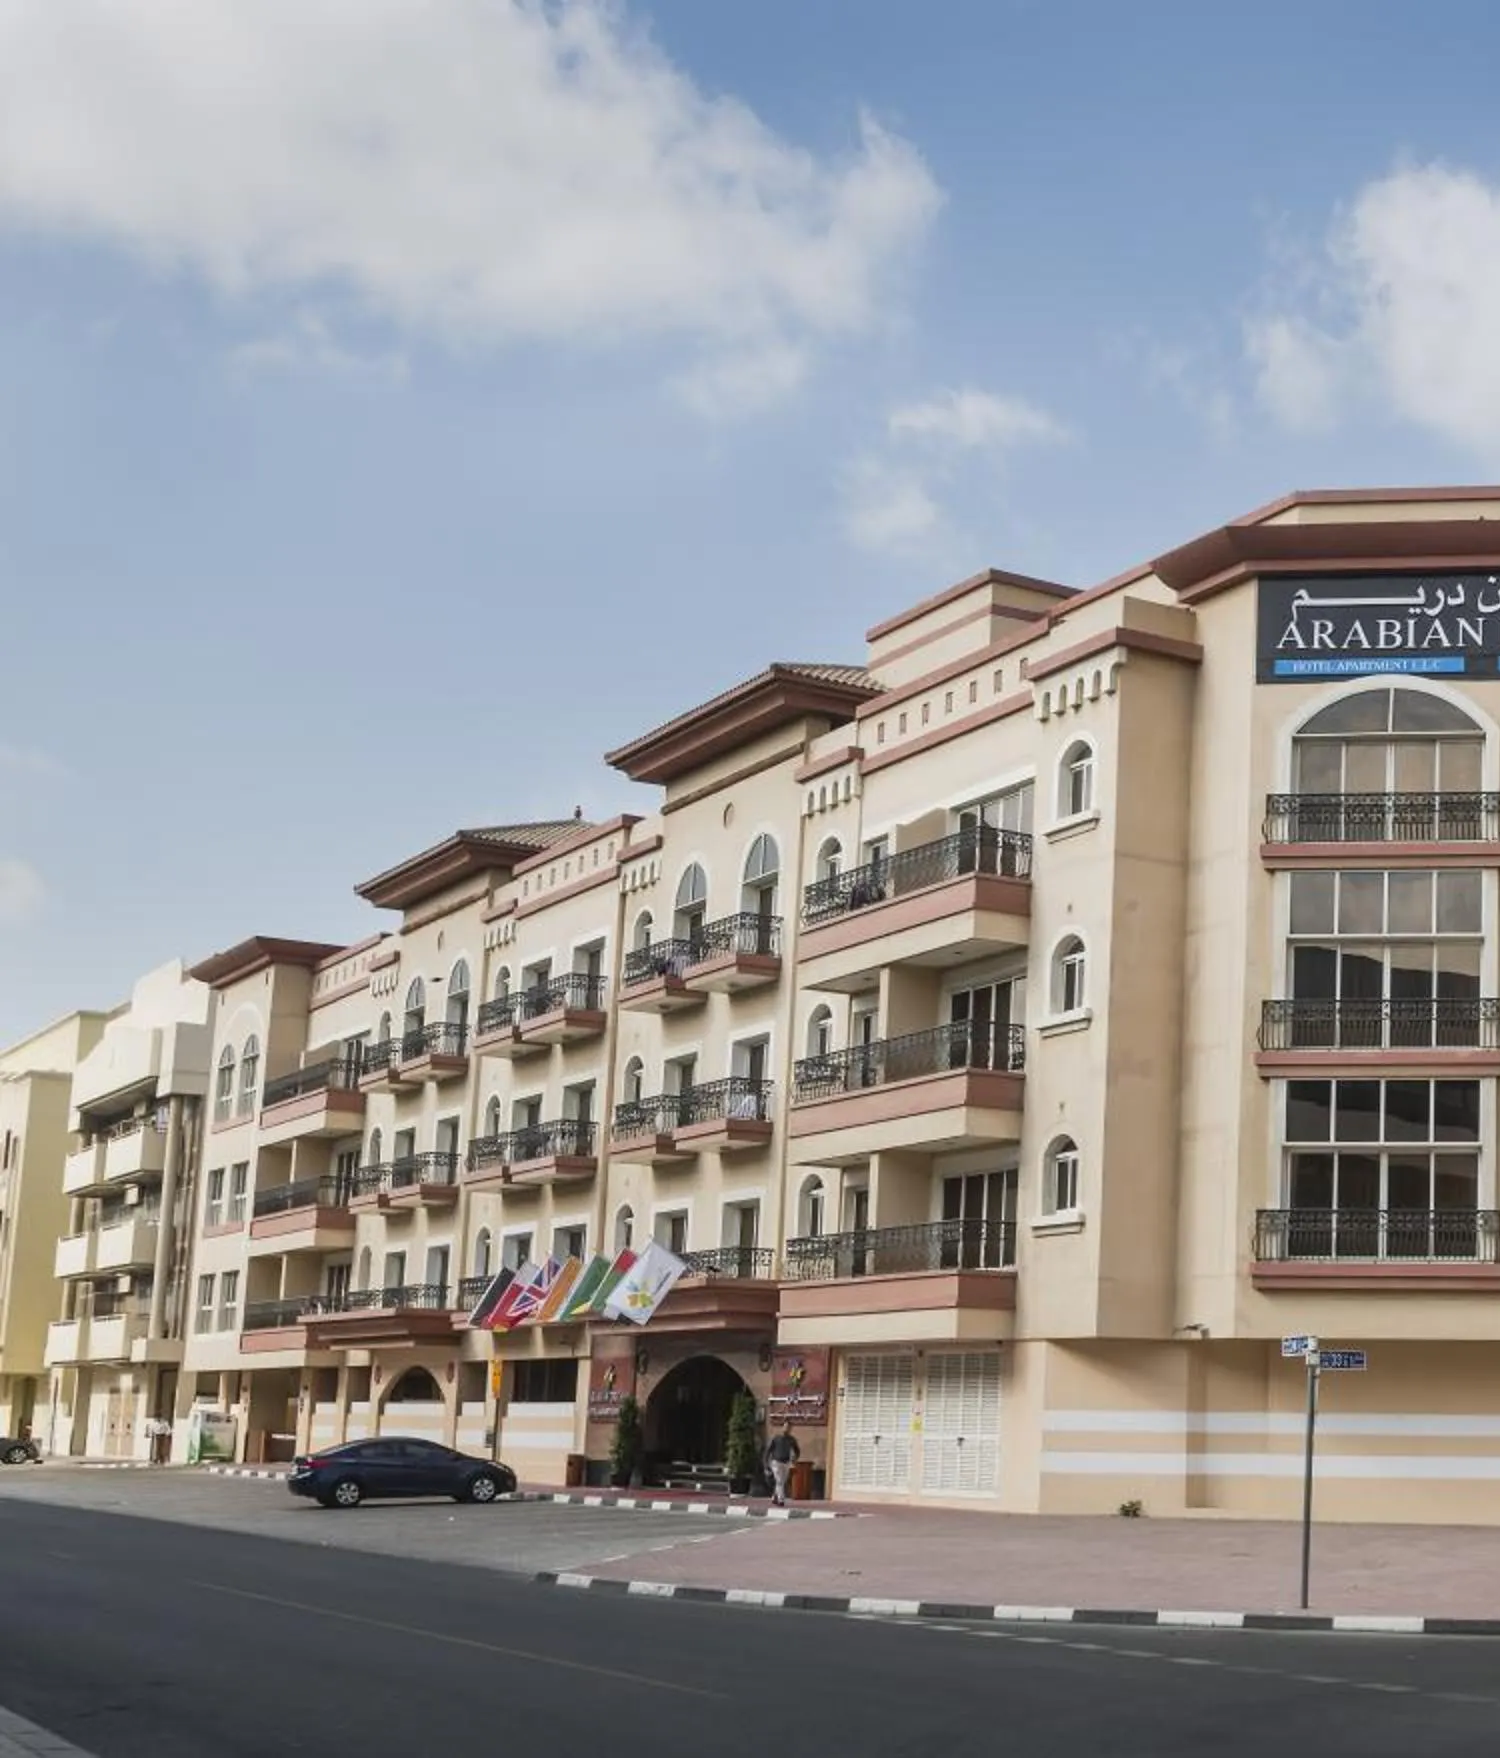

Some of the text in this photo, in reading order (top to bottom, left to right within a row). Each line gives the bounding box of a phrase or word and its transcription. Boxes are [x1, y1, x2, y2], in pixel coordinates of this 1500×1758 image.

[1291, 582, 1465, 624] دريم
[1276, 617, 1486, 650] ARABIAN
[1293, 660, 1334, 674] HOTEL
[1336, 659, 1408, 673] APARTMENT
